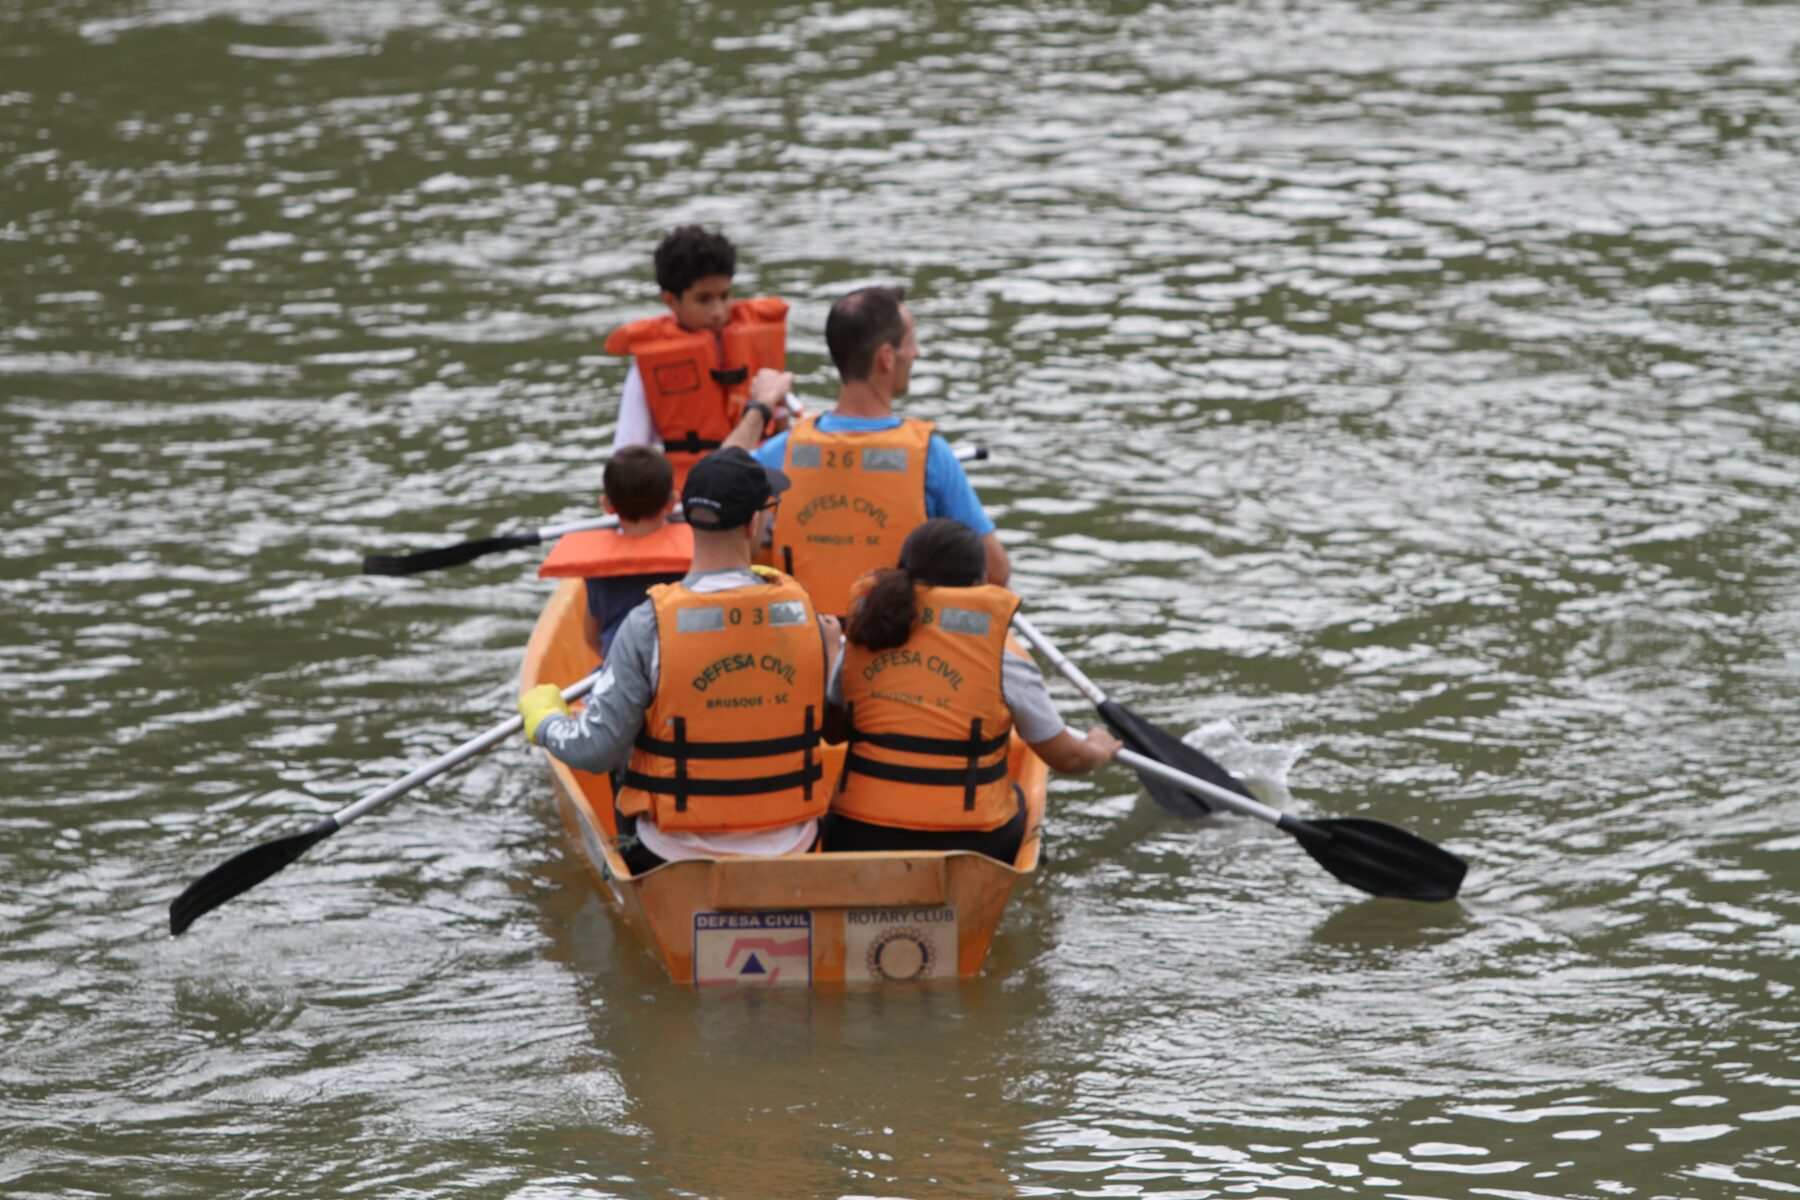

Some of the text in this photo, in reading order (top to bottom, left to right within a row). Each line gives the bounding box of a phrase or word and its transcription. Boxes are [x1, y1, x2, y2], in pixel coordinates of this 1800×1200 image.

[796, 493, 890, 529] DEFESA CIVIL
[691, 653, 798, 692] DEFESA CIVIL
[862, 650, 964, 692] DEFESA CIVIL
[706, 695, 763, 709] BRUSQUE
[775, 693, 789, 705] SC
[697, 913, 809, 928] DEFESA CIVIL
[847, 908, 954, 925] ROTARY CLUB
